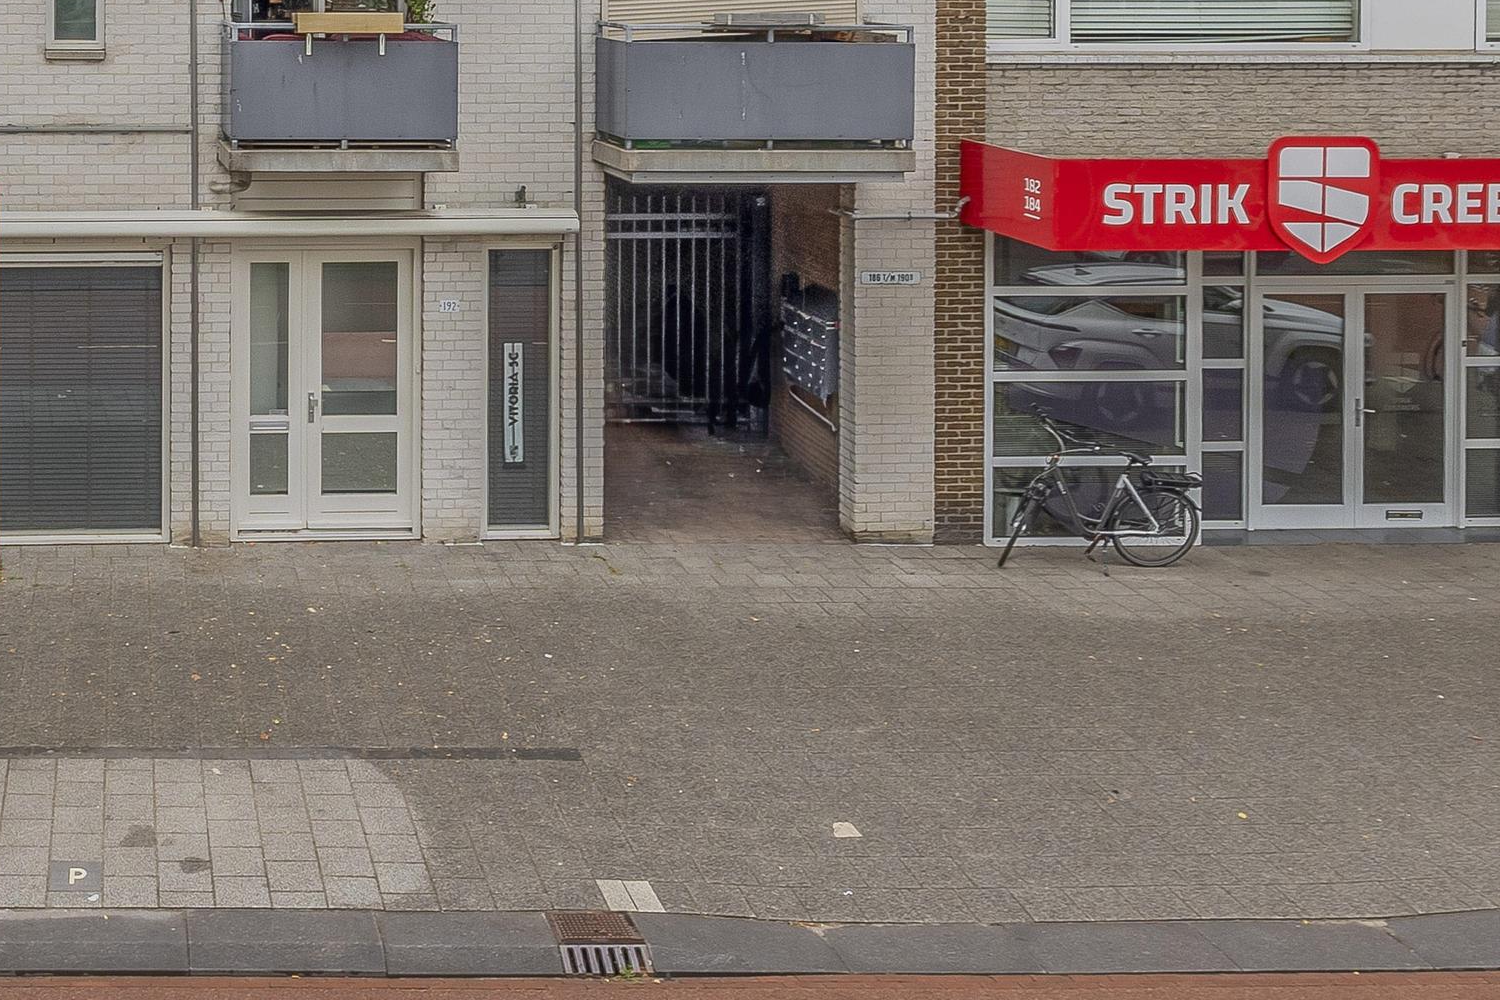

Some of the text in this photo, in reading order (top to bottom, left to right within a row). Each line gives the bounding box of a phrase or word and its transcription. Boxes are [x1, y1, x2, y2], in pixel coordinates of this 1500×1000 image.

[1024, 177, 1041, 194] 182
[1024, 195, 1041, 212] 184
[1102, 183, 1250, 225] STRIK
[443, 301, 457, 312] 192
[69, 867, 87, 885] P
